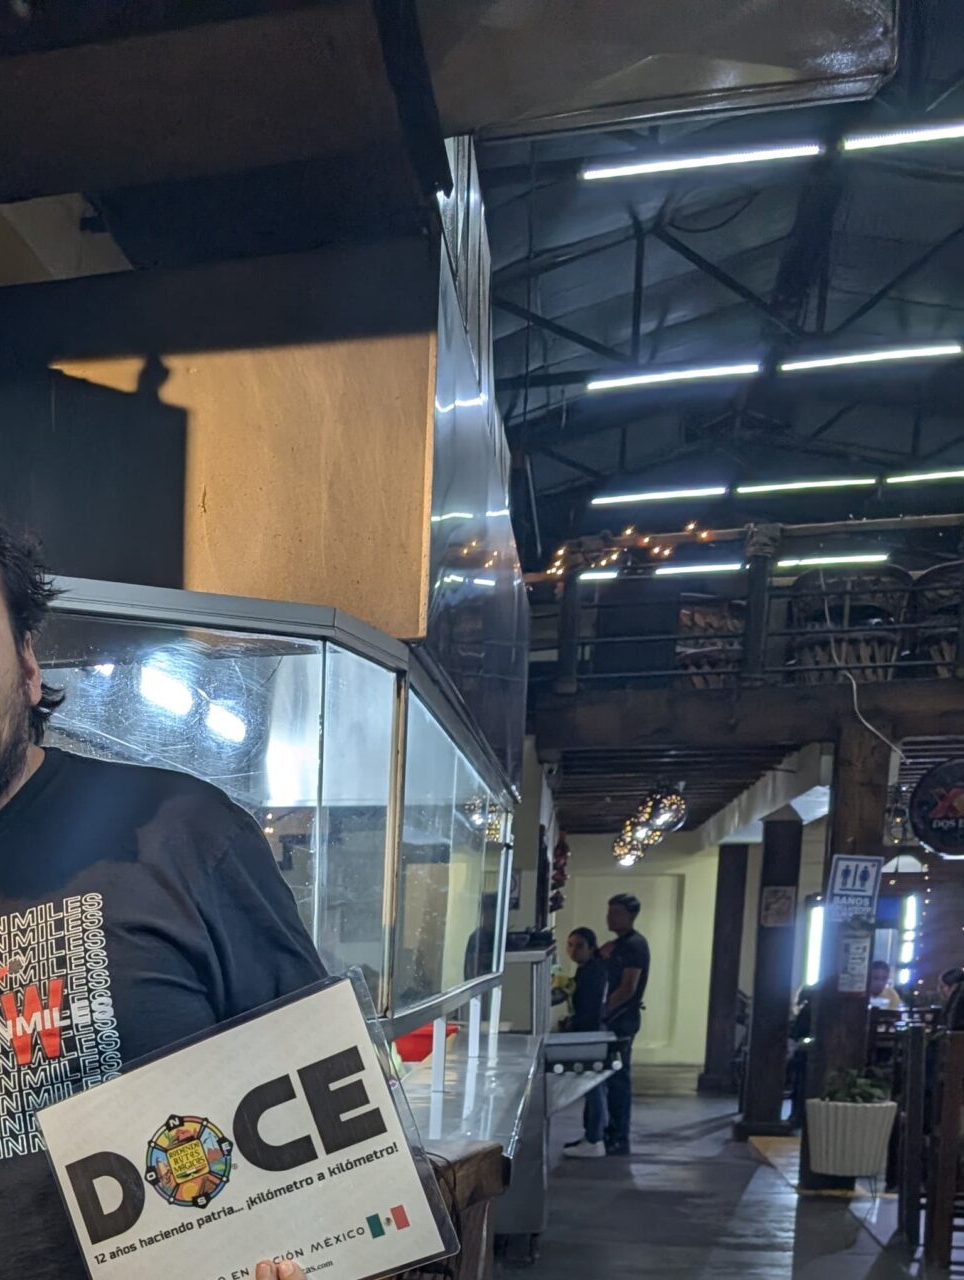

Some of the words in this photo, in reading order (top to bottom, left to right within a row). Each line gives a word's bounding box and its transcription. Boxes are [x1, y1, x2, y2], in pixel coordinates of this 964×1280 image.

[94, 1253, 107, 1266] 12
[109, 1242, 138, 1261] años
[138, 1220, 195, 1249] haciendo
[196, 1204, 244, 1230] patria...
[246, 1175, 314, 1211] ¡kilómetro
[317, 1171, 326, 1182] a
[328, 1141, 399, 1178] kilómetro!
[231, 1267, 250, 1280] EN
[273, 1248, 305, 1265] CIÓN
[310, 1226, 365, 1253] MÉXICO
